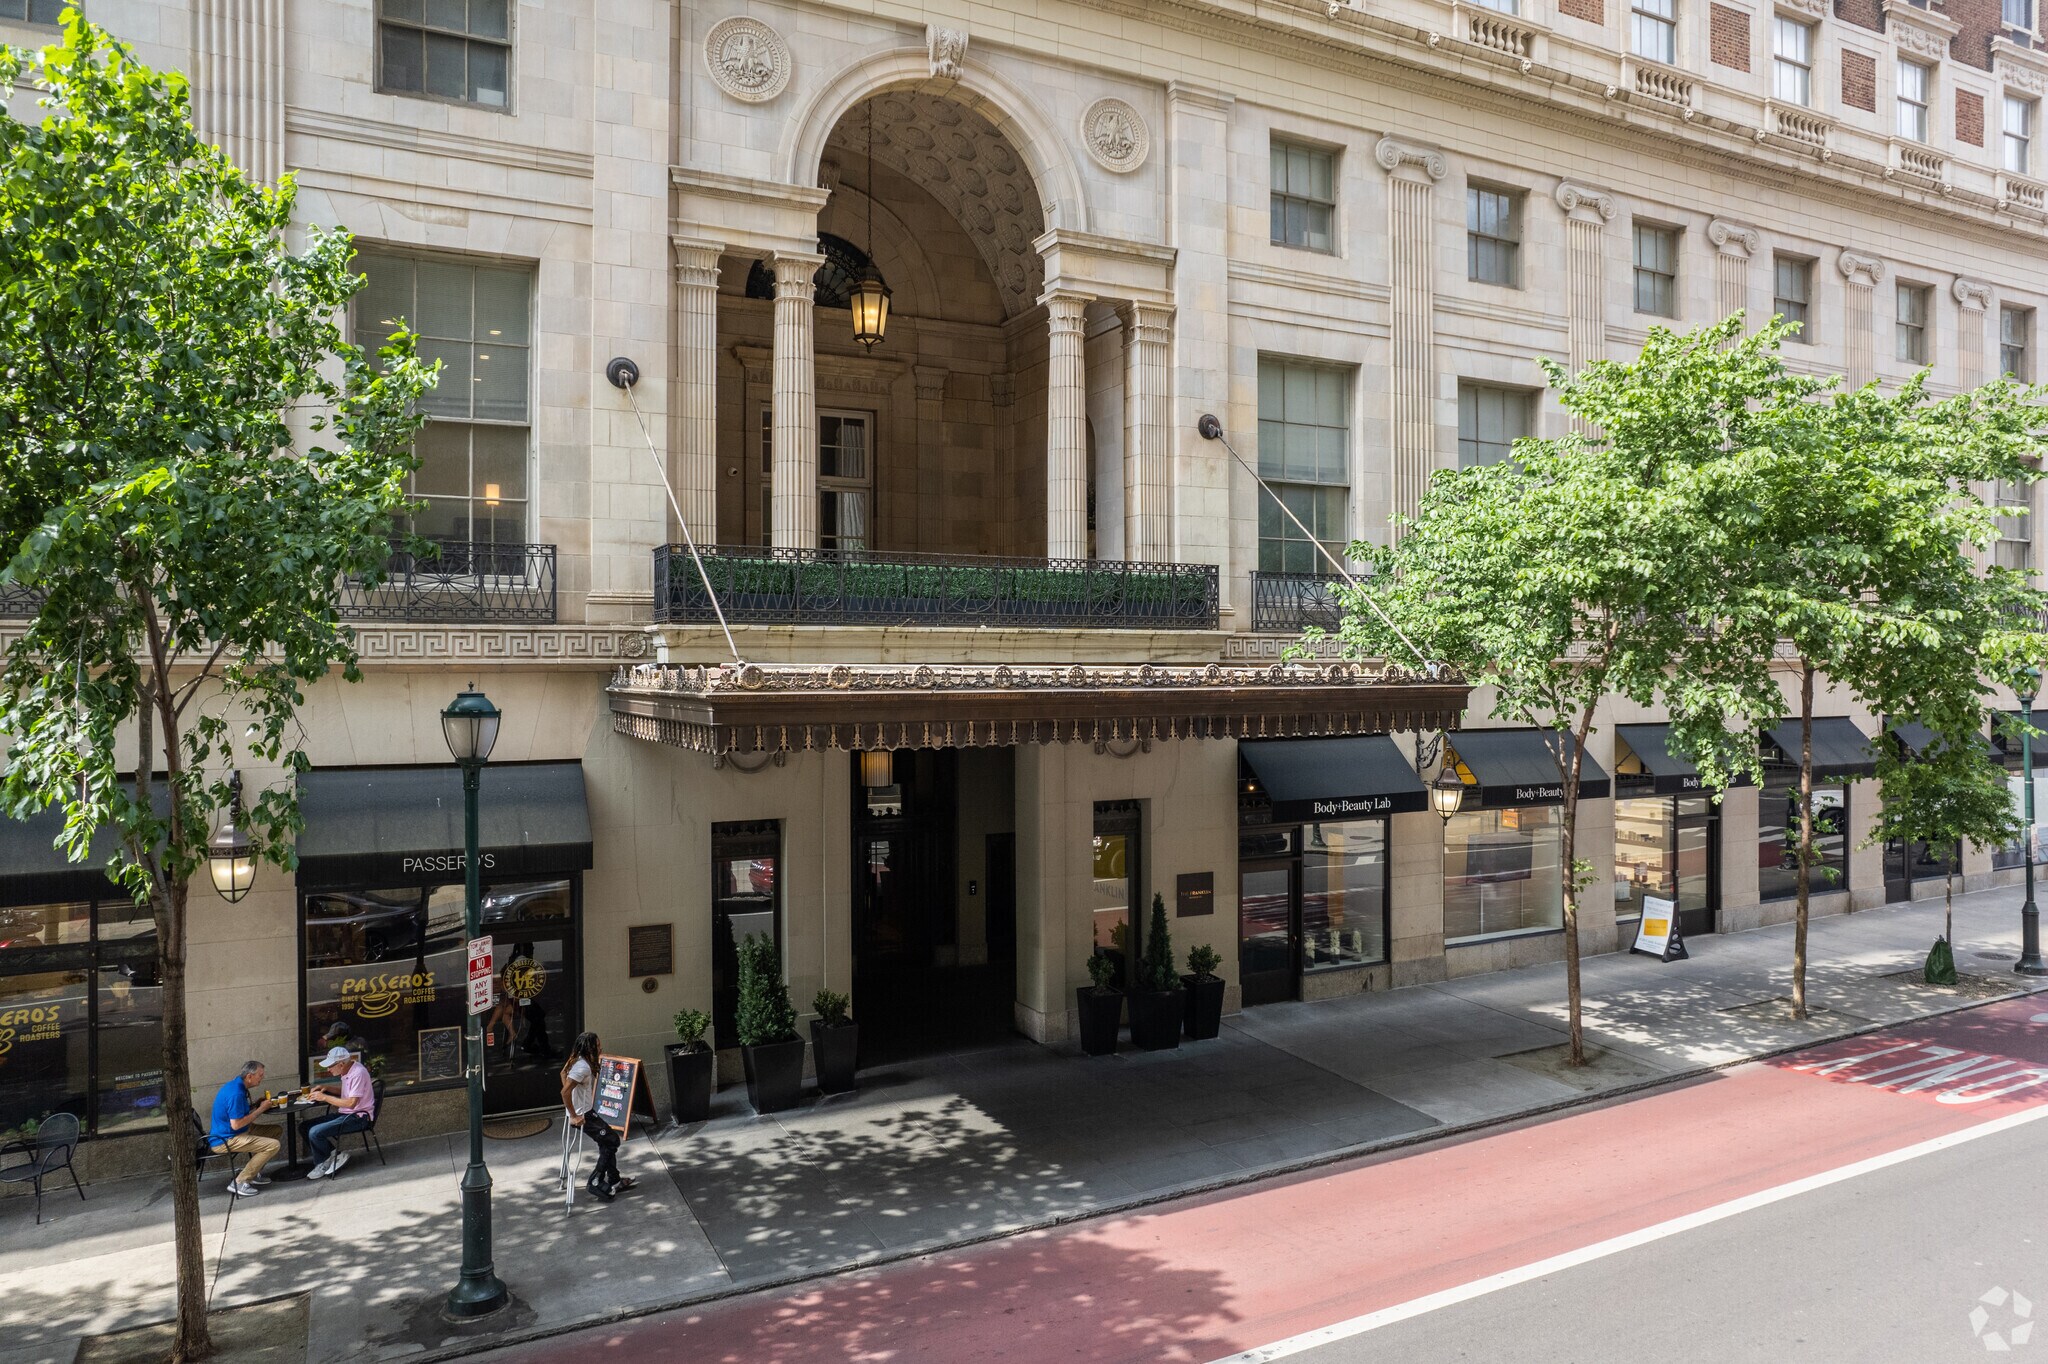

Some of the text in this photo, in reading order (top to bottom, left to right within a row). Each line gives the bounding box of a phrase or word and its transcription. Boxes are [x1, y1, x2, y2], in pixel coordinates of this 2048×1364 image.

[1516, 787, 1563, 800] Body+Beauty
[1314, 797, 1391, 815] Body+Beauty Lab
[403, 853, 495, 873] PASSER'S
[476, 957, 486, 970] NO
[470, 966, 491, 980] STOPPING
[341, 971, 436, 995] PASSERO'S
[474, 980, 488, 991] ANY
[412, 987, 435, 996] COFFEE
[474, 988, 488, 999] TIME
[341, 994, 358, 1002] SINCE
[403, 994, 436, 1004] ROASTERS
[341, 1002, 355, 1010] 1990
[31, 1022, 61, 1033] COFFEE
[19, 1030, 61, 1043] ROASTERS
